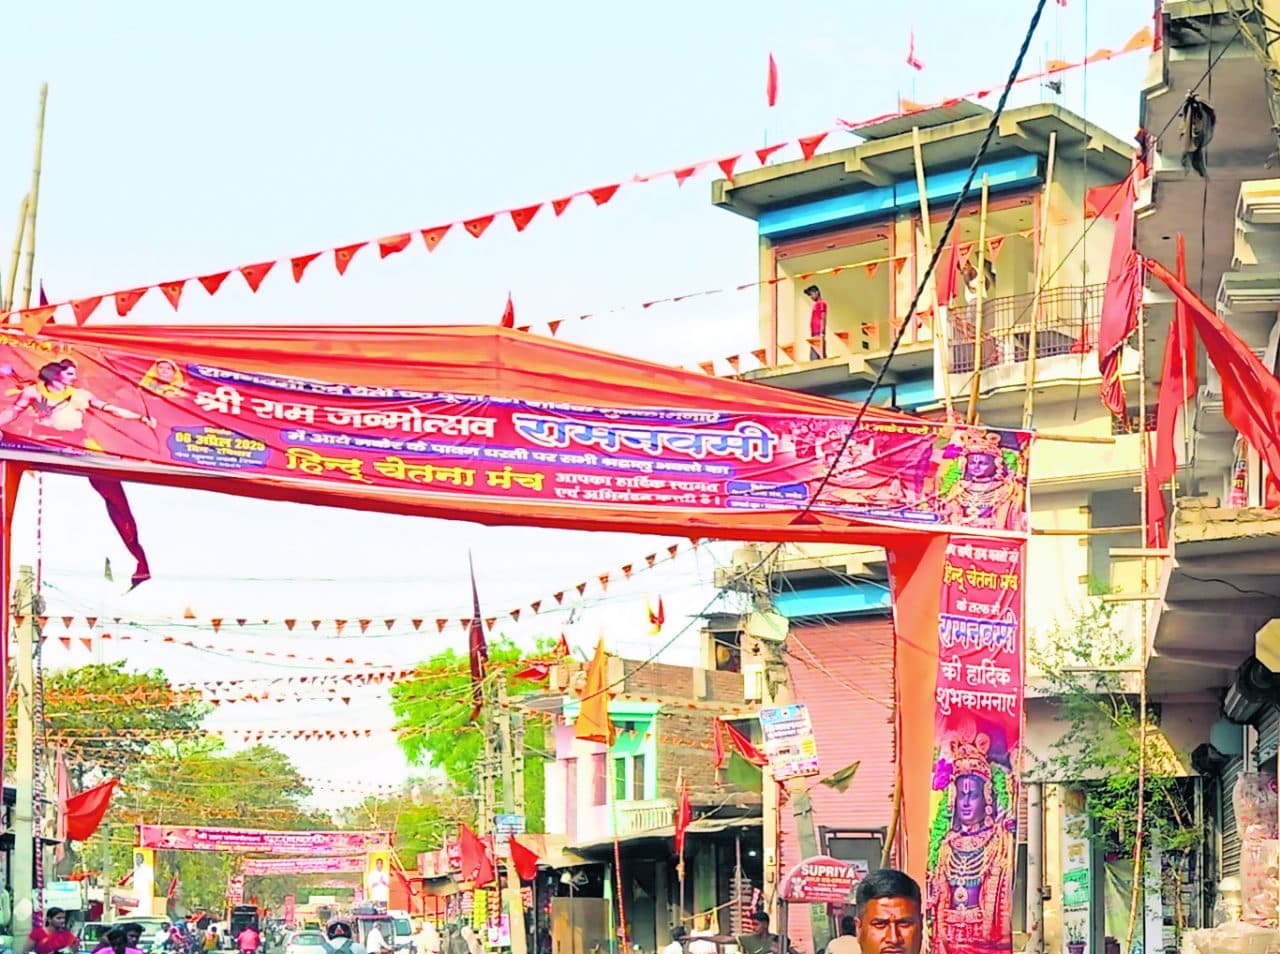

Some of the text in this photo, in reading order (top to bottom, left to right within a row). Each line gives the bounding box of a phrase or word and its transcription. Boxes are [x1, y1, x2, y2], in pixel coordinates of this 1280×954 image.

[194, 386, 498, 440] श्री राम जन्मोत्सव
[512, 411, 781, 463] रामनवमी
[285, 447, 374, 484] हिन्दू
[373, 456, 476, 488] चेतना
[486, 466, 545, 492] मंच
[554, 471, 612, 485] आपका
[966, 563, 998, 590] चेतना
[940, 654, 1012, 688] की हार्दिक
[801, 863, 855, 879] SUPRIYA
